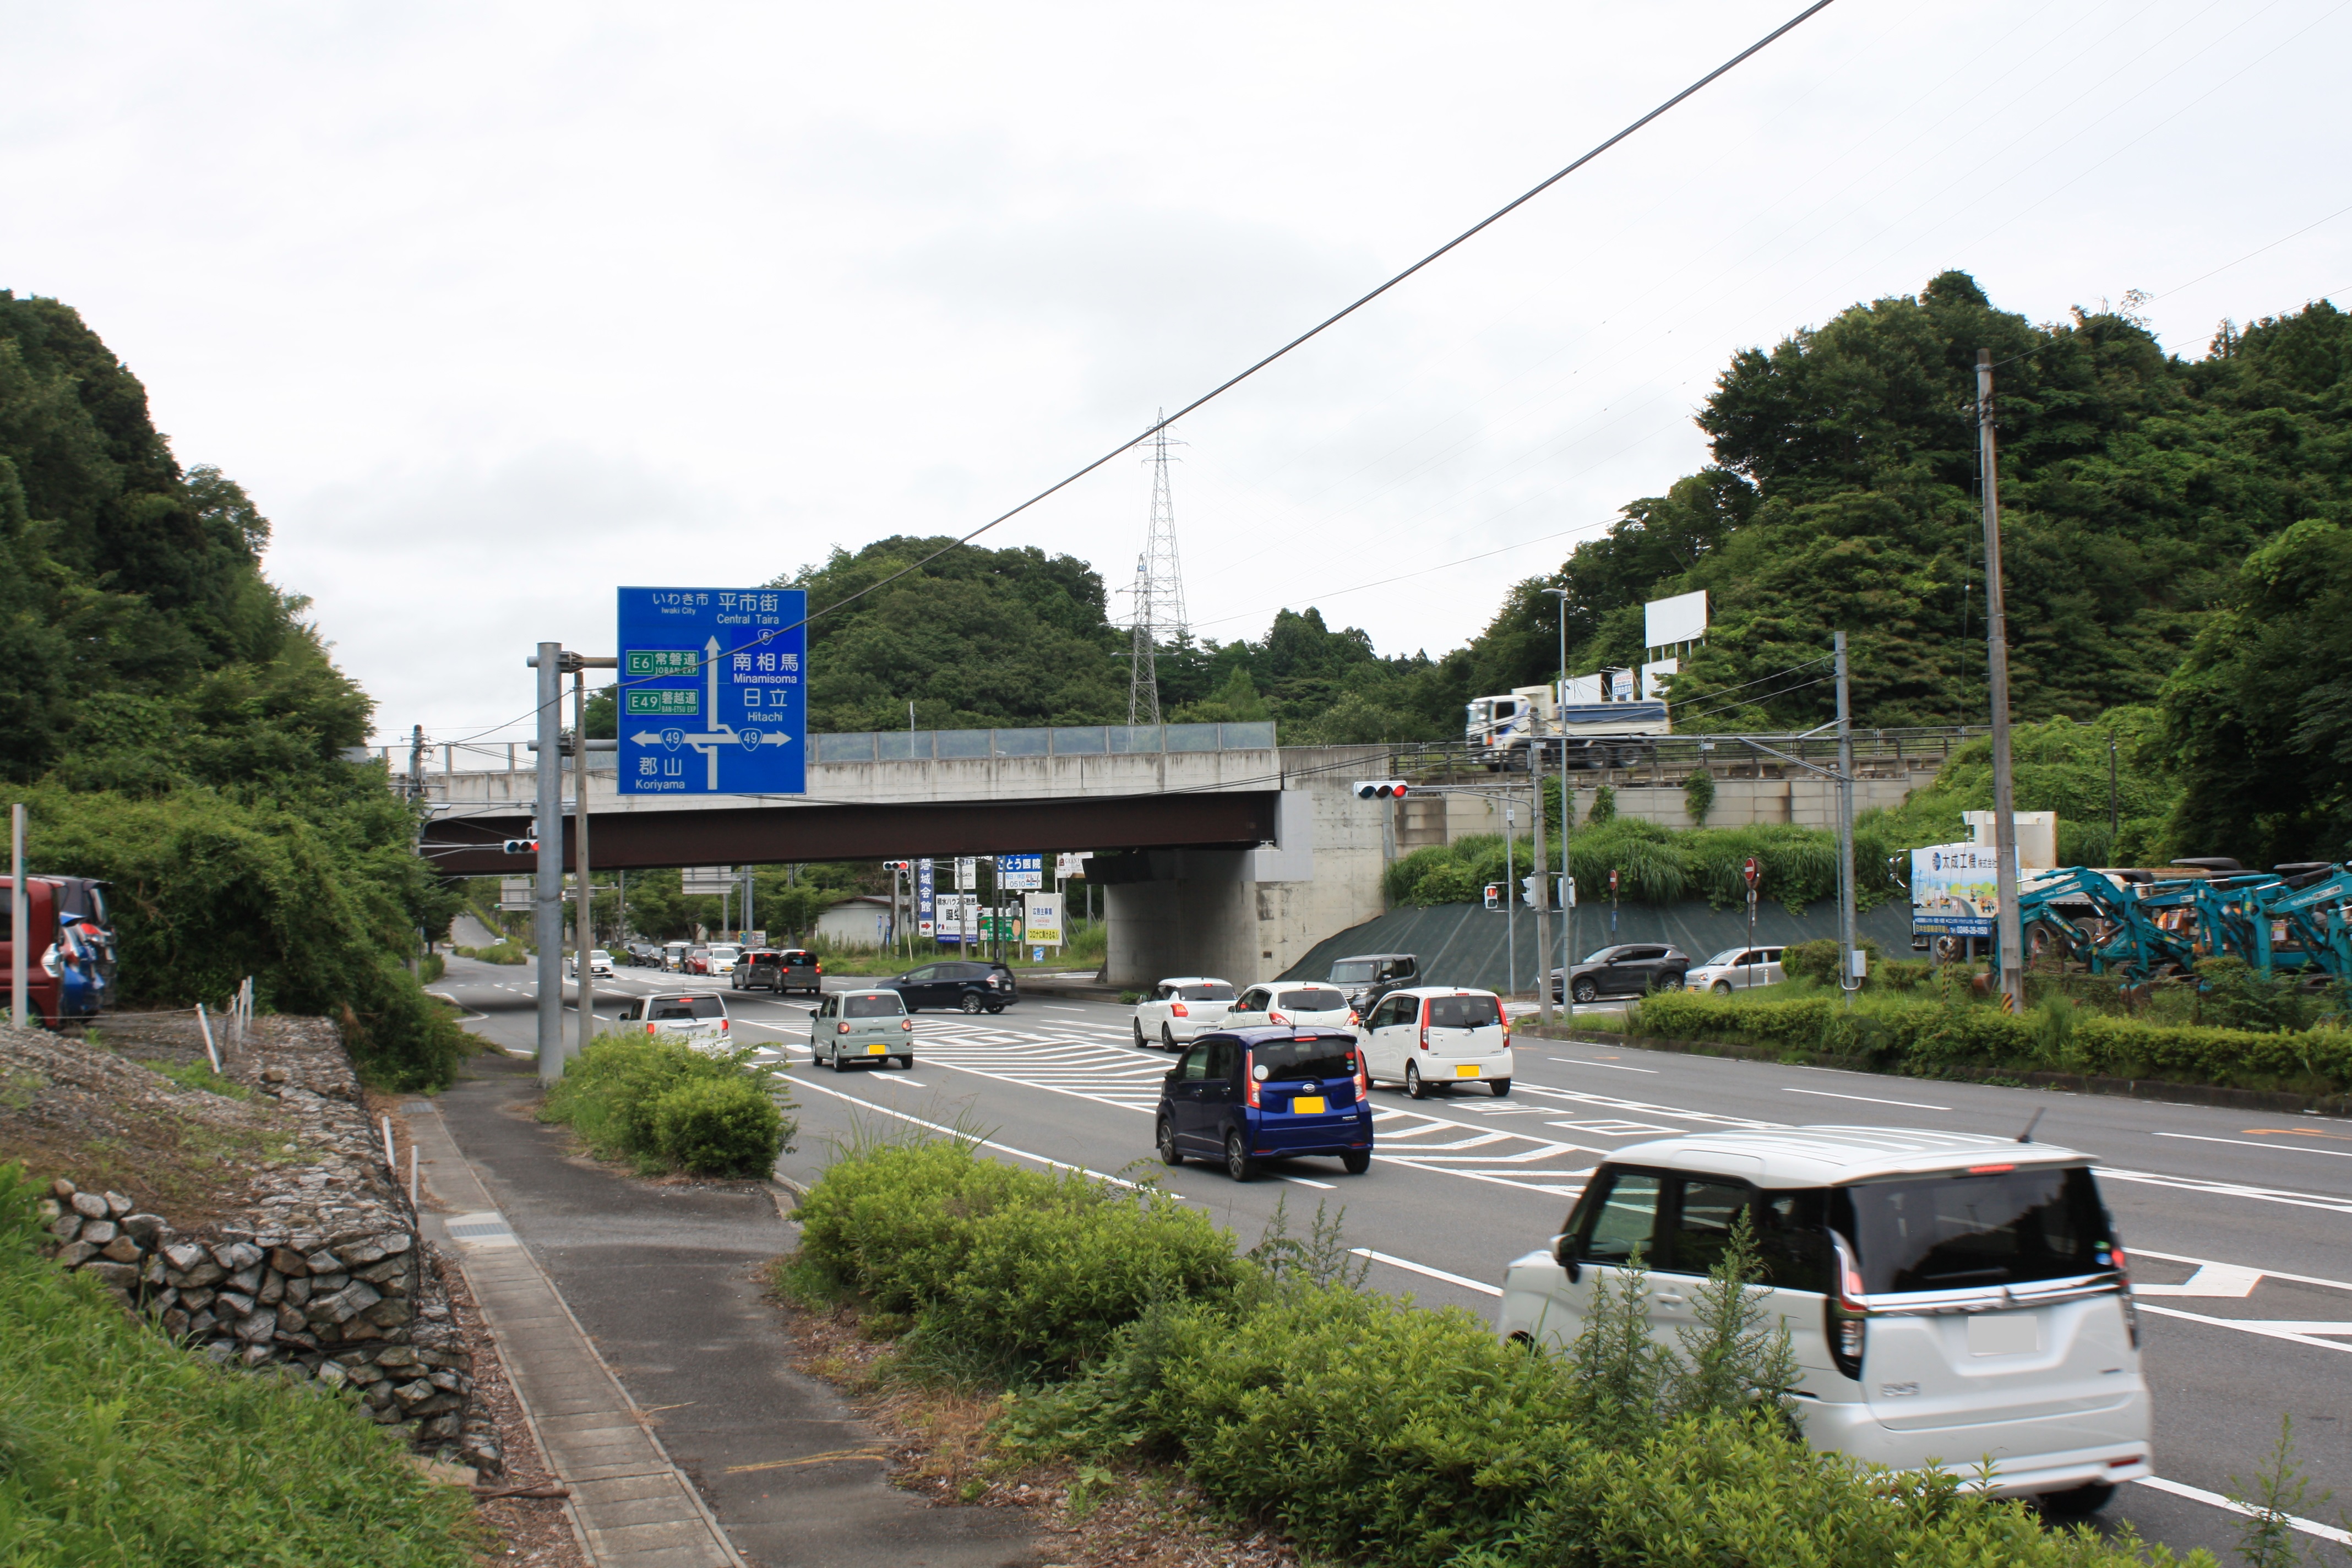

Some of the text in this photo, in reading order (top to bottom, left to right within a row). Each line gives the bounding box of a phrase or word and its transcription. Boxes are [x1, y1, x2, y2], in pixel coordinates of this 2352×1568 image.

[653, 592, 709, 606] いわき市
[718, 592, 778, 612] 平市街
[681, 607, 696, 616] City
[716, 613, 779, 624] Central Taira
[633, 657, 650, 668] E6
[655, 652, 698, 666] 常磐道
[733, 652, 798, 672] 南相馬
[733, 673, 797, 684] Minamisoma
[631, 696, 658, 707] E49
[661, 692, 696, 704] 磐越道
[744, 688, 787, 707] 日立
[748, 711, 782, 722] Hitachi
[665, 732, 680, 745] 49
[743, 732, 758, 745] 49
[639, 757, 682, 776] 郡山
[635, 779, 685, 791] Koriyama
